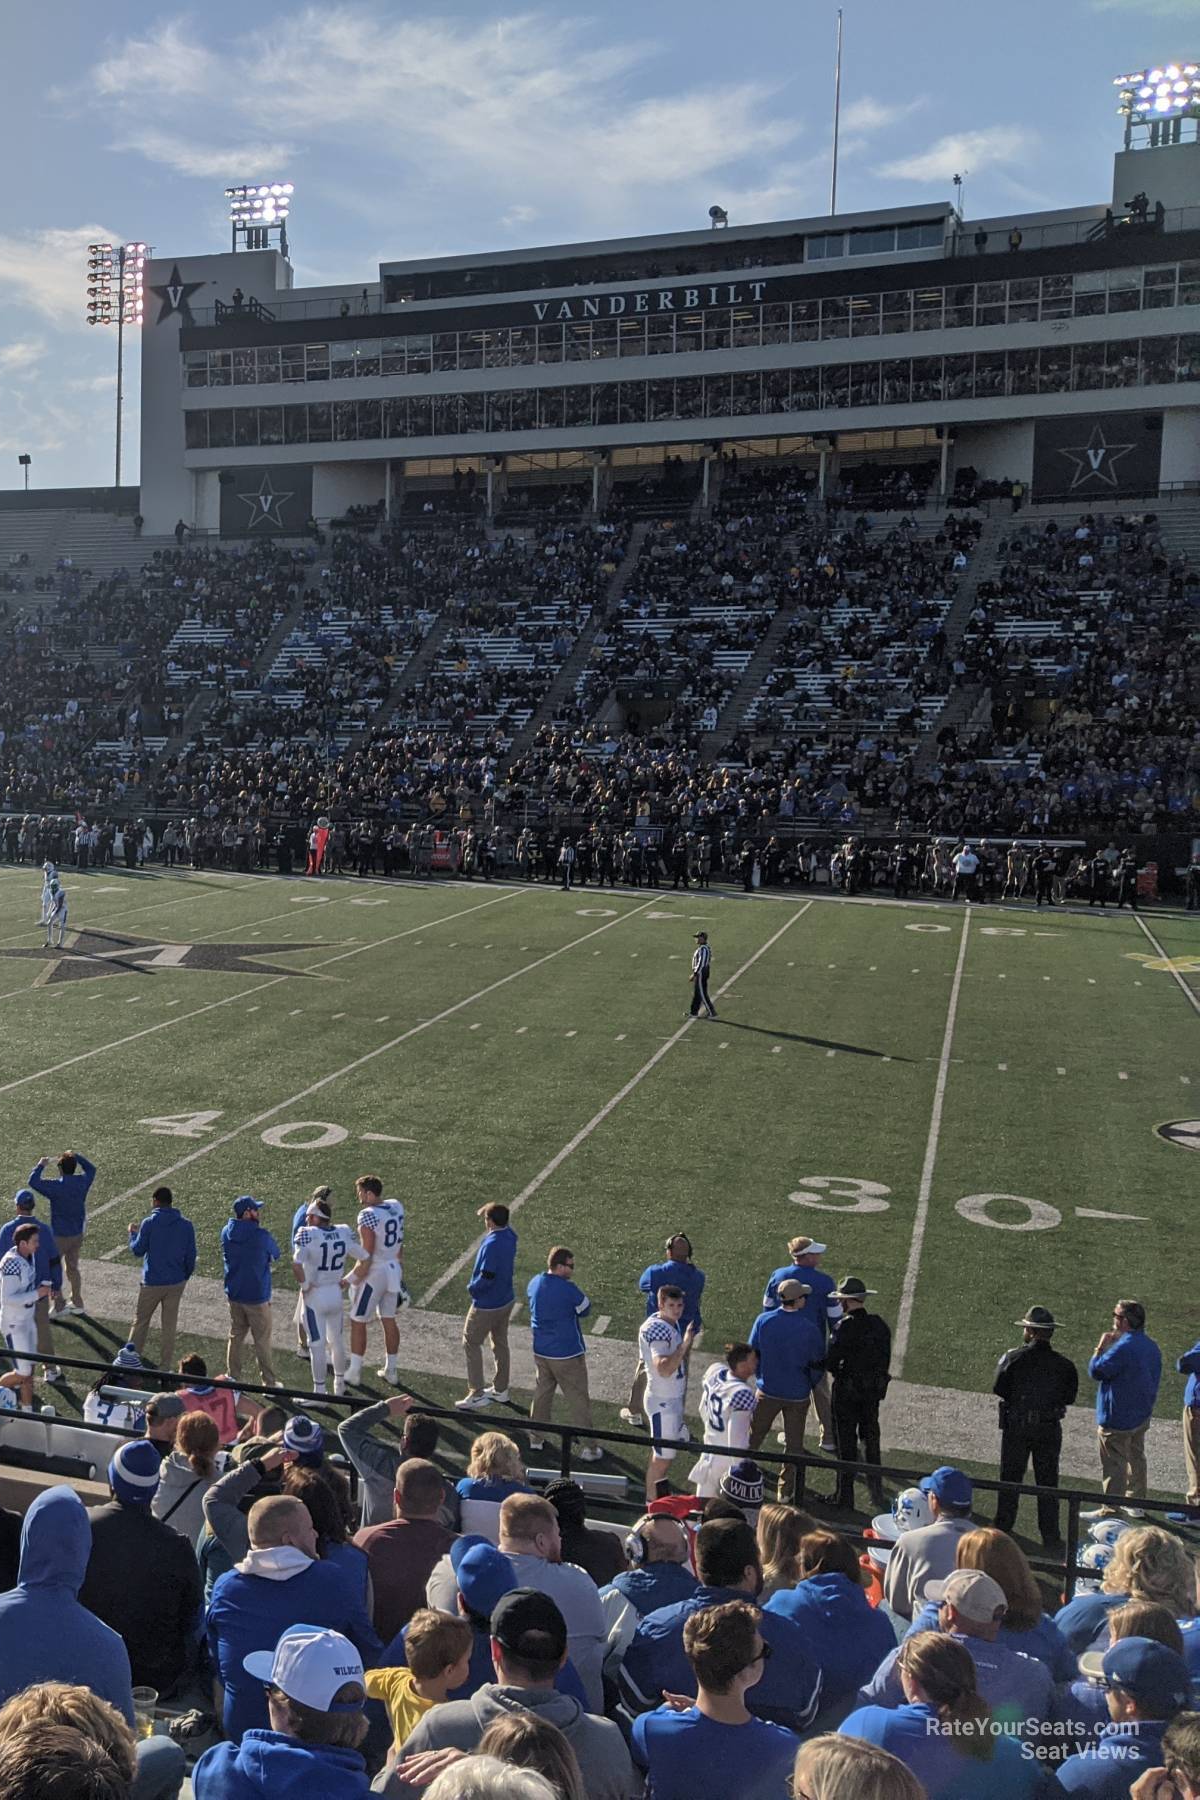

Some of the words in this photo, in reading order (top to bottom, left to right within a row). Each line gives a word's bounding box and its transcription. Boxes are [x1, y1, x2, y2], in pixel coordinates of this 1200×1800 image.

[167, 286, 185, 309] V
[533, 281, 767, 321] VANDERBILT
[1087, 448, 1106, 470] V
[259, 495, 273, 513] V
[317, 1240, 347, 1271] 12
